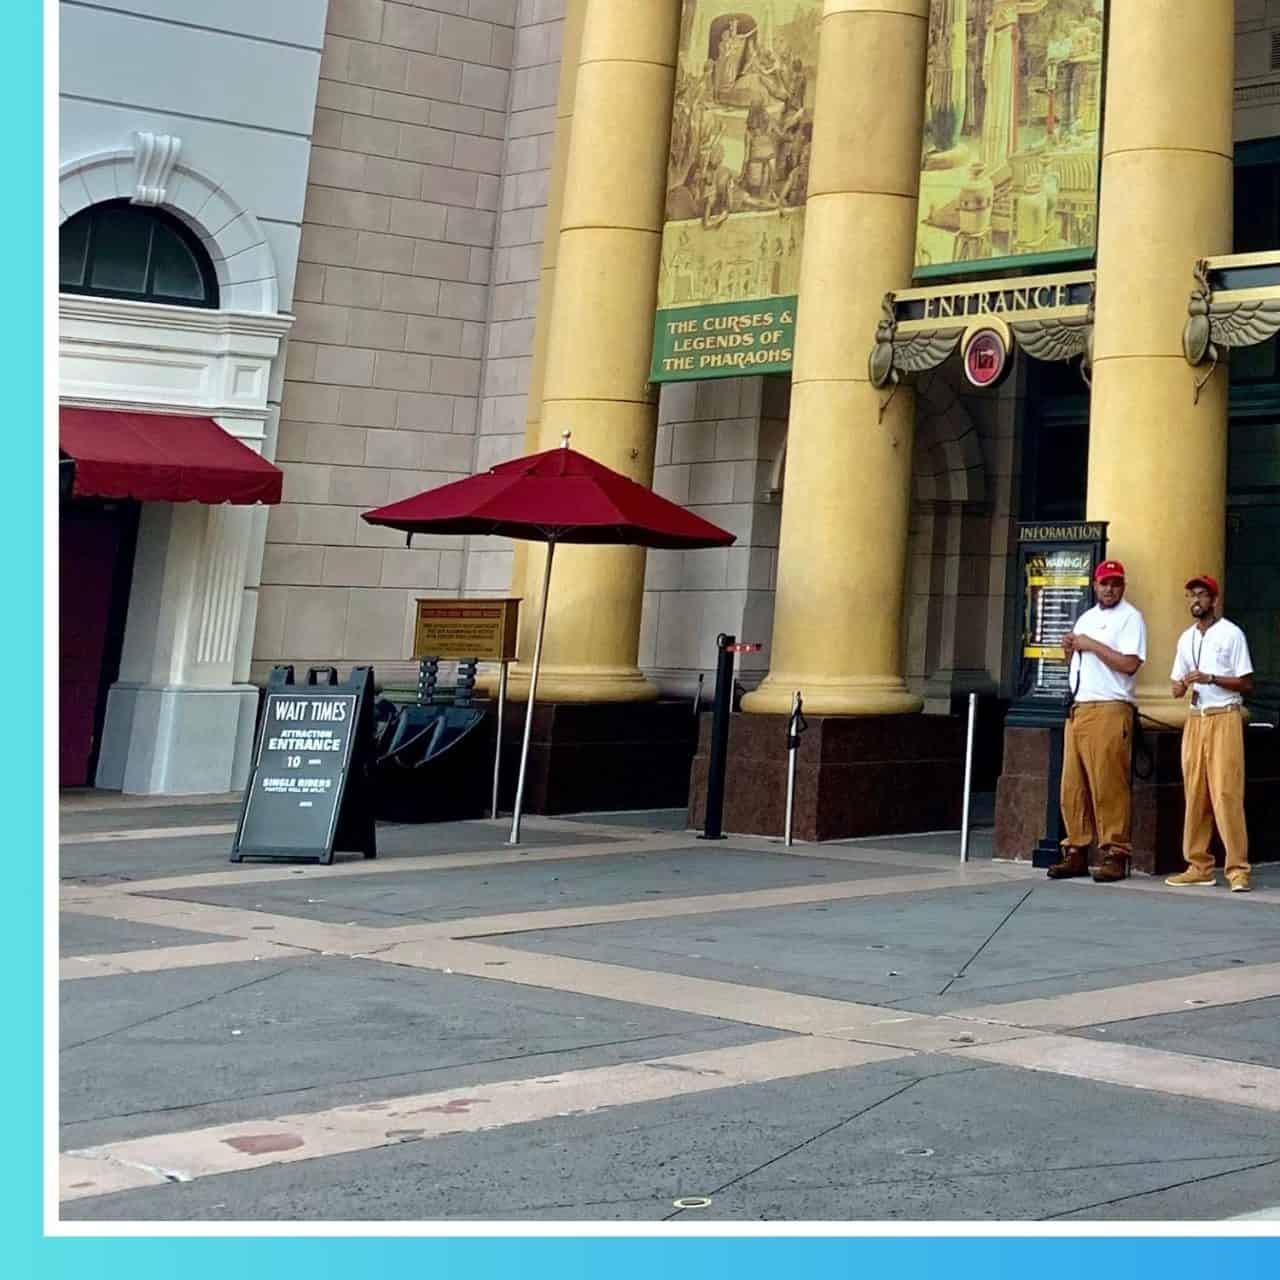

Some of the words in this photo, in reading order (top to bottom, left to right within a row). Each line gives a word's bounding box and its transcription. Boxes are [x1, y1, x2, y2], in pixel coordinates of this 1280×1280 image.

[924, 285, 1067, 319] ENTRANCE
[666, 320, 698, 335] THE
[703, 312, 774, 332] CURSES
[779, 310, 793, 324] &
[673, 333, 754, 352] LEGENDS
[760, 330, 784, 345] OF
[662, 356, 695, 371] THE
[700, 348, 793, 369] PHARAOHS
[1020, 526, 1101, 539] INFORMATION
[275, 701, 308, 721] WAIT
[311, 701, 347, 721] TIMES
[280, 729, 333, 738] ATTRACTION
[268, 738, 341, 751] ENTRANCE
[287, 755, 301, 768] 10
